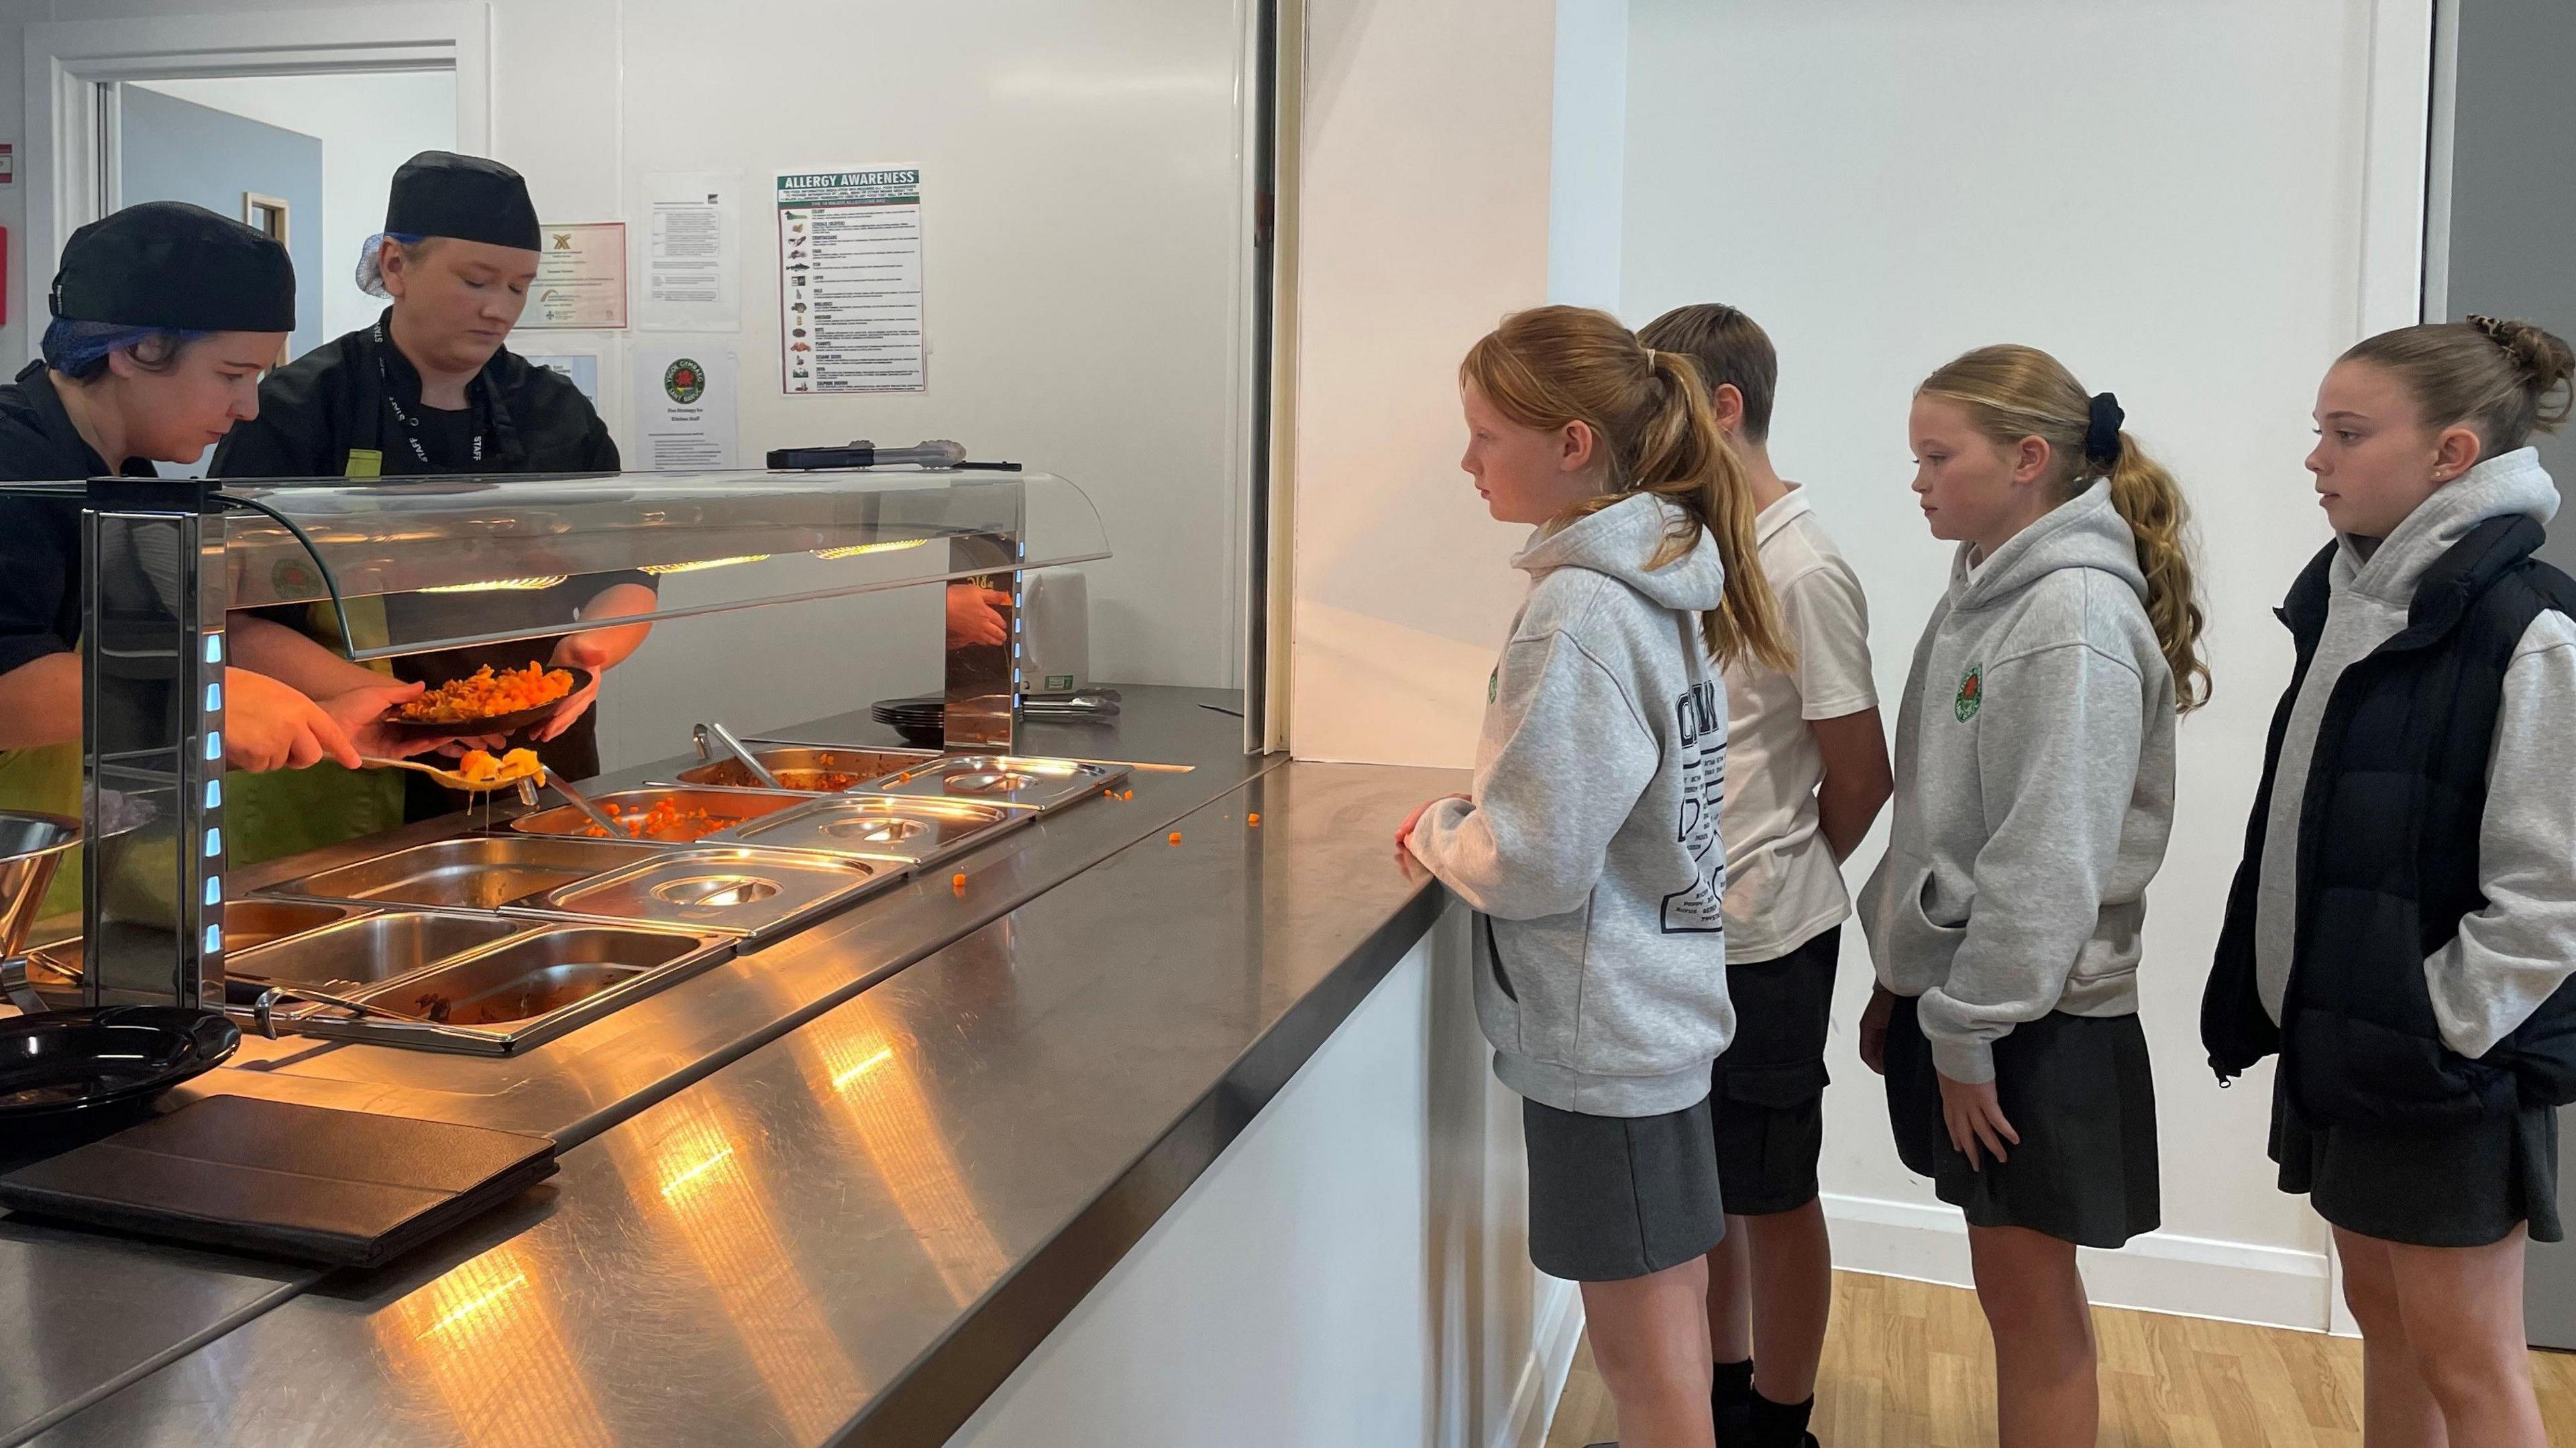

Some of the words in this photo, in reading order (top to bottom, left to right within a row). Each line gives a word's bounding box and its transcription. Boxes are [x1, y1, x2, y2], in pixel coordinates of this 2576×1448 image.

[785, 174, 837, 188] ALLERGY
[840, 171, 915, 186] AWARENESS
[409, 437, 429, 463] STAFF
[472, 435, 482, 461] STAFF
